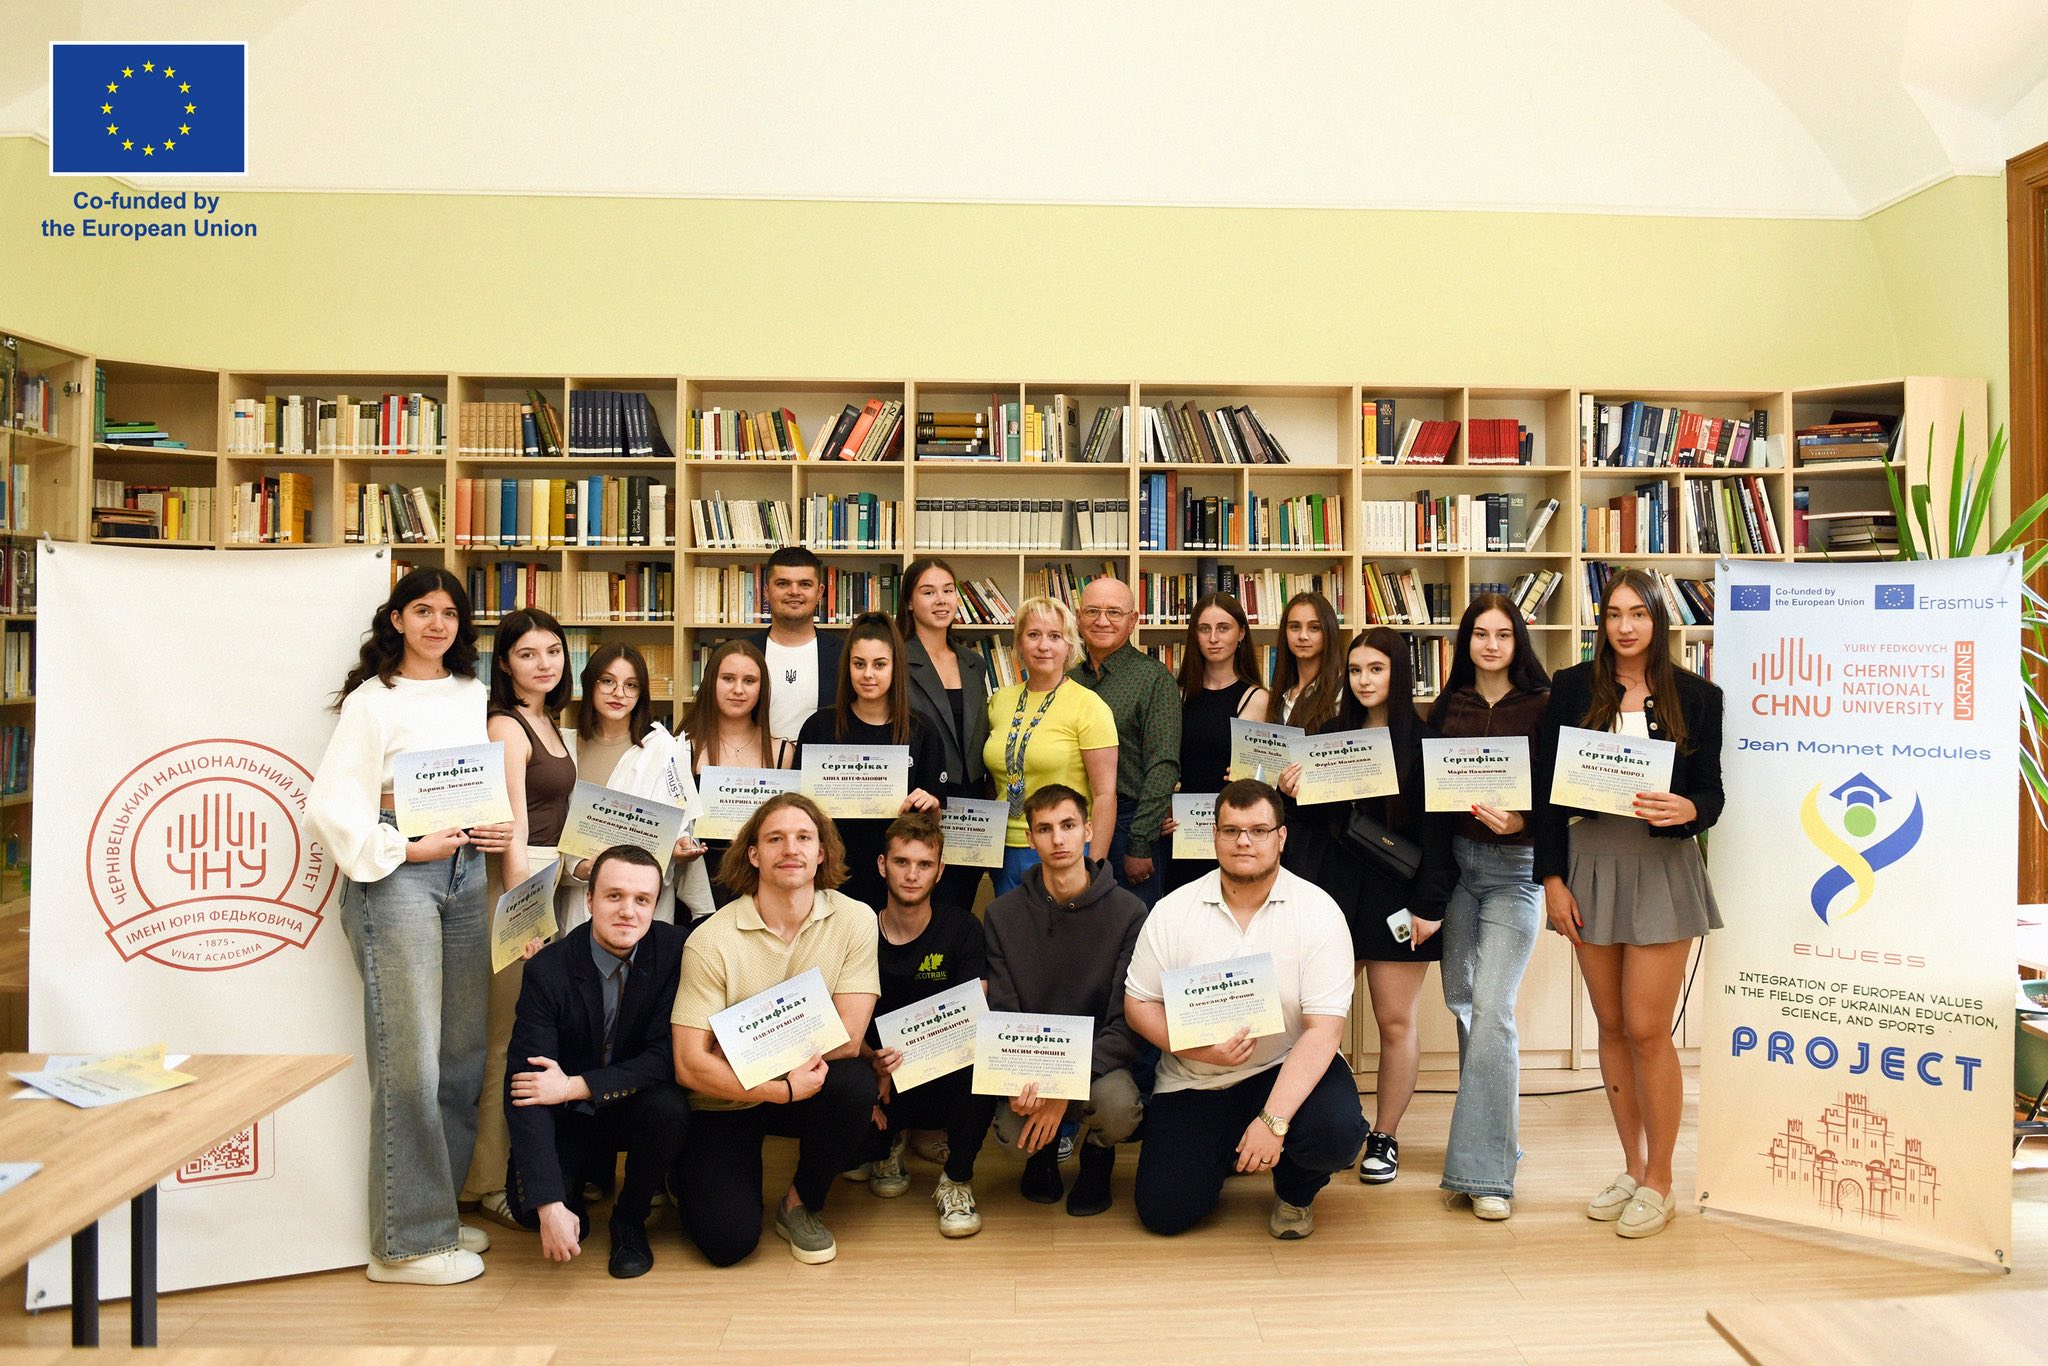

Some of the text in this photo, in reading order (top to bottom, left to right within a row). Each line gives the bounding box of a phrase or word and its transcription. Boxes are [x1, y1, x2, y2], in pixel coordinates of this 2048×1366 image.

[1775, 587, 1836, 598] Co-funded by
[1775, 598, 1865, 608] the European Union
[1919, 596, 2008, 610] Erasmus+
[1844, 643, 1948, 653] YURIY FEDKOVYCH
[1843, 664, 1945, 679] CHERNIVTSI
[1955, 643, 1973, 718] UKRAINE
[1842, 682, 1930, 697] NATIONAL
[1751, 694, 1832, 718] CHNU
[1842, 701, 1944, 715] UNIVERSITY
[1244, 734, 1287, 748] Сертифіка
[1737, 738, 1991, 760] Jean Monnet Modules
[1309, 744, 1373, 759] Сертифікат
[1443, 754, 1510, 764] Сертифікат
[1578, 749, 1652, 767] Сертифікат
[415, 764, 485, 780] Сертифікат
[821, 762, 889, 771] Сертифікат
[592, 802, 661, 827] Сертифікат
[941, 814, 990, 823] ртифікат
[106, 782, 154, 905] ЧЕРНІВЕЦЬКИЙ
[153, 755, 294, 791] НАЦІОНАЛЬНИЙ
[126, 909, 304, 944] ІМЕНІ ЮРІЯ ФЕДЬКОВИЧА
[205, 938, 229, 947] 1875
[171, 942, 262, 962] VIVAT ACADEMIA
[1184, 978, 1255, 996] Сертифікат
[1739, 971, 1984, 1011] INTEGRATION OF EUROPEAN VALUES
[738, 996, 808, 1034] Сертифікат
[1724, 984, 1999, 1030] IN THE FIELDS OF UKRAINIAN EDUCATION,
[900, 1004, 967, 1035] Сертифікат
[1781, 1006, 1935, 1035] SCIENCE, AND SPORTS
[998, 1032, 1071, 1044] Сертифікат
[1731, 1025, 1982, 1092] PROJECT
